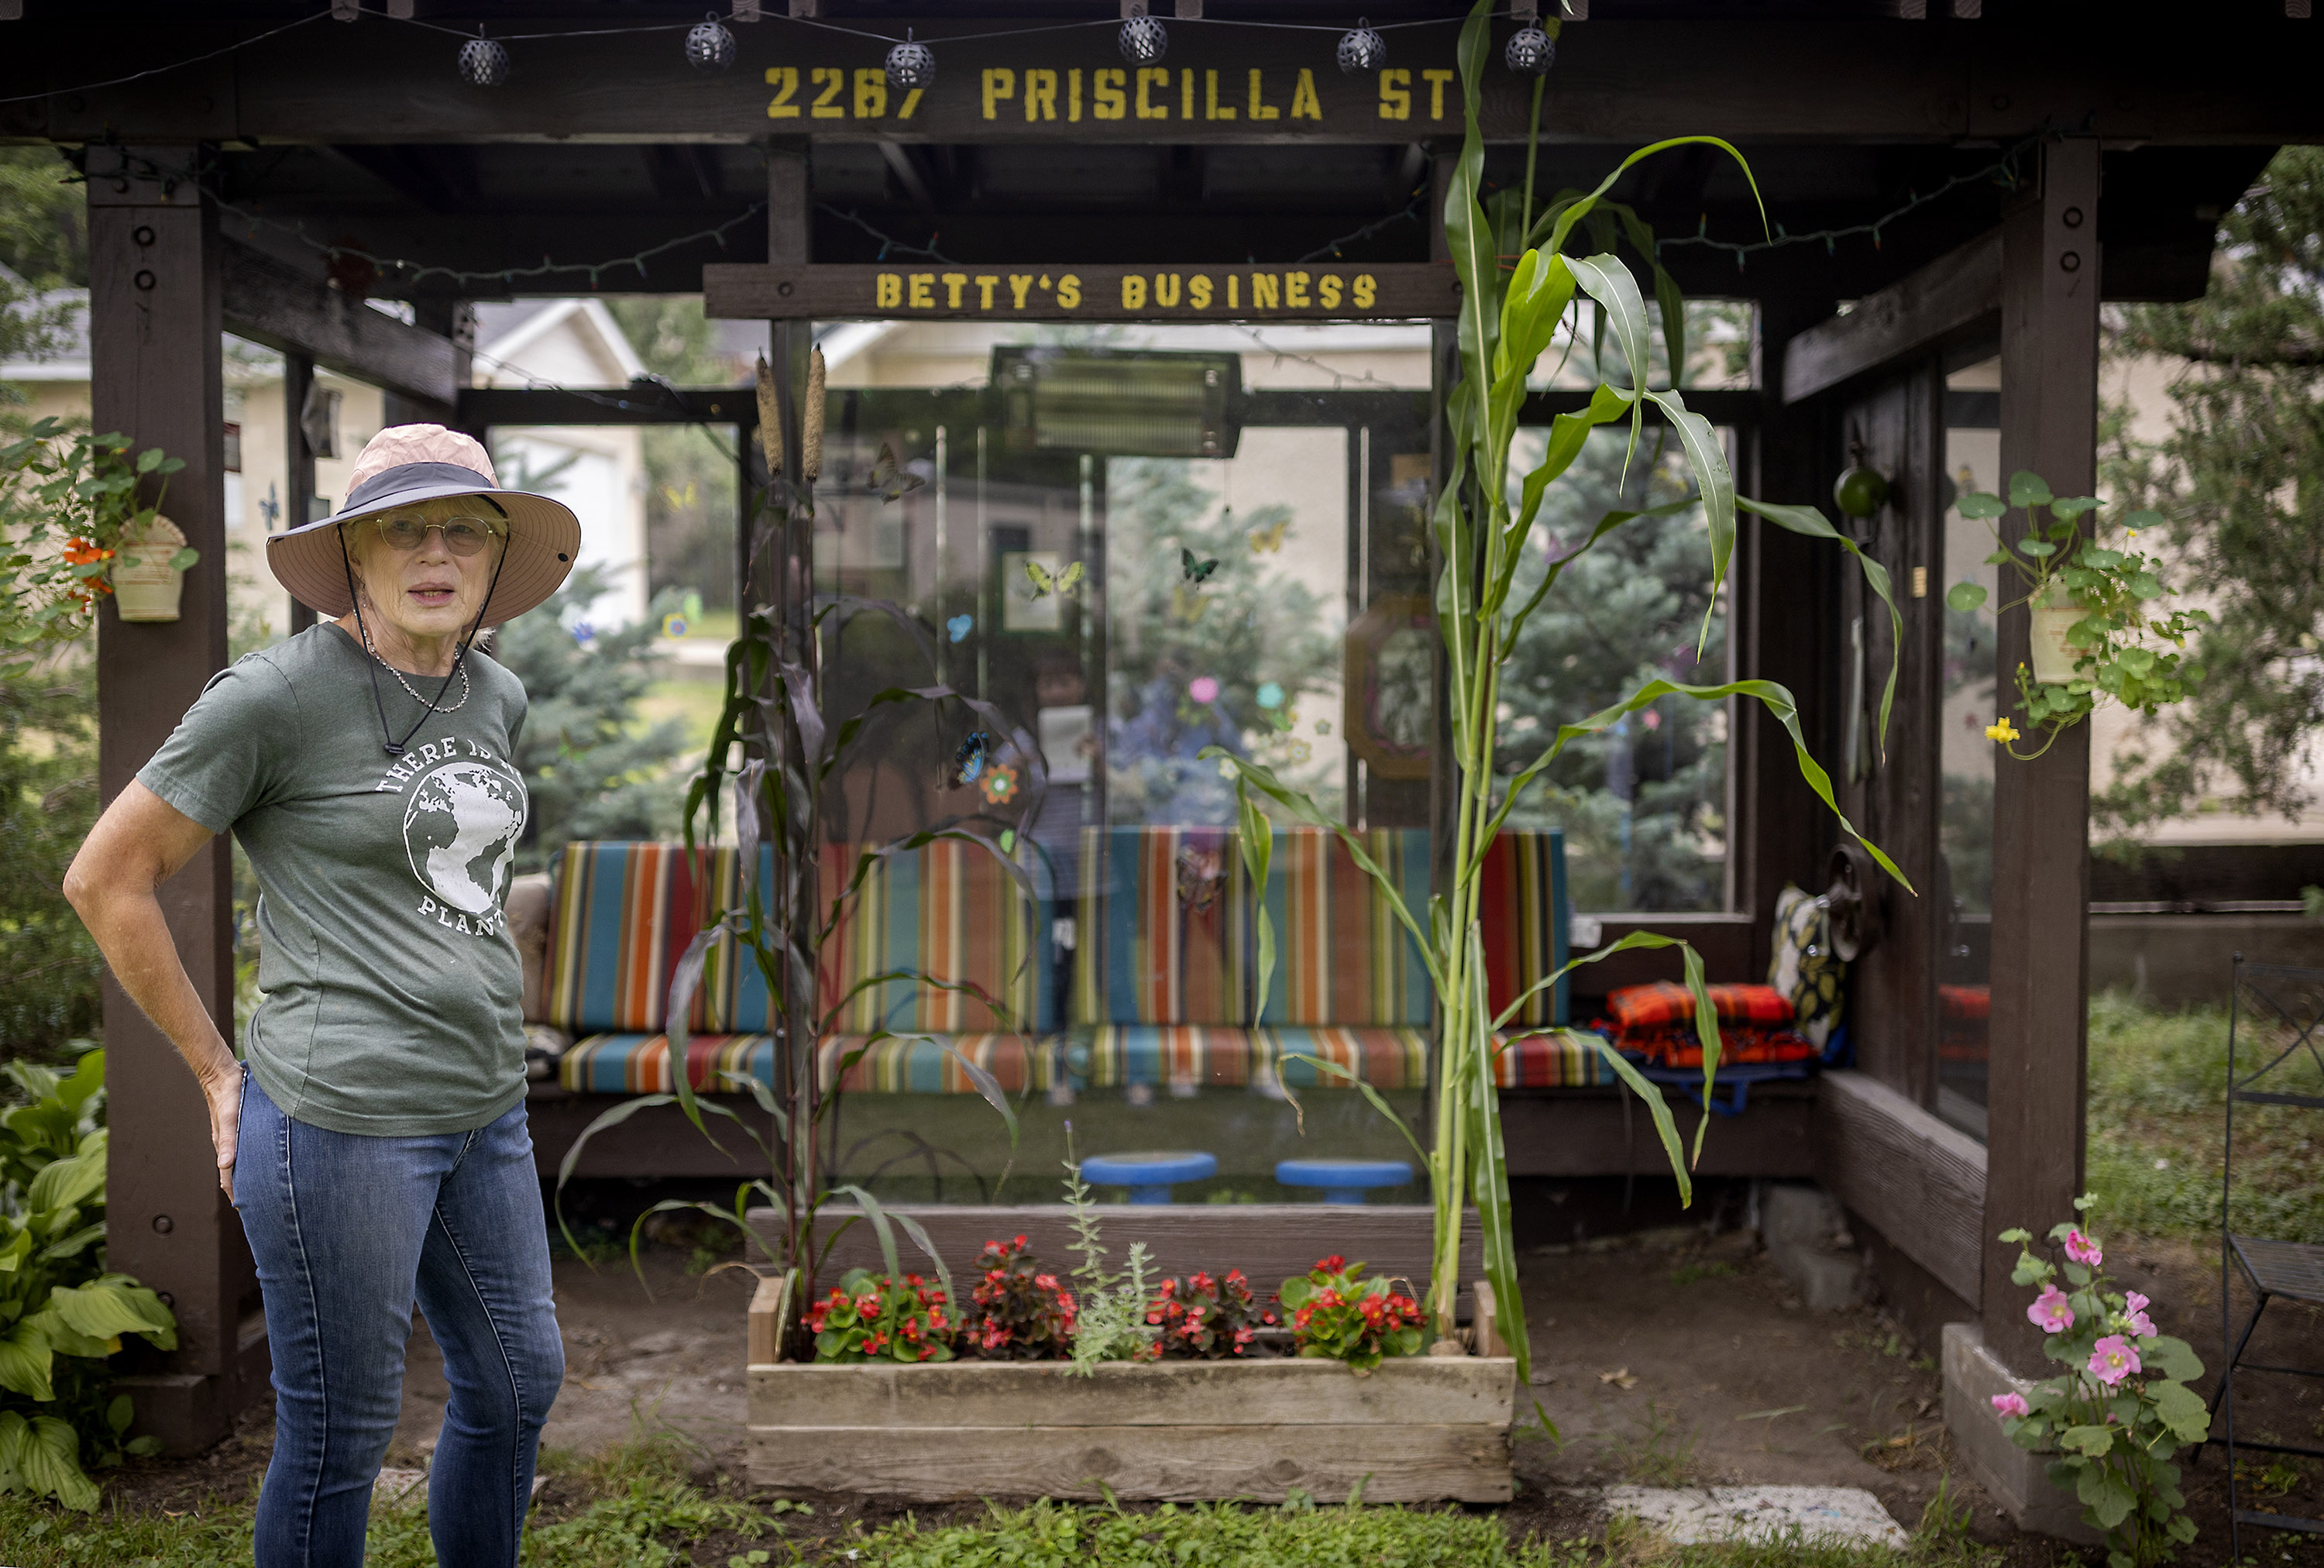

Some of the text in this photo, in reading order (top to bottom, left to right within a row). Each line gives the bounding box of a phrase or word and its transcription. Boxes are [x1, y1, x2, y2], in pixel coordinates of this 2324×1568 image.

[982, 67, 1322, 122] PRISCILLA
[876, 271, 1377, 310] BETTY'S BUSINESS
[376, 737, 457, 793] THERE
